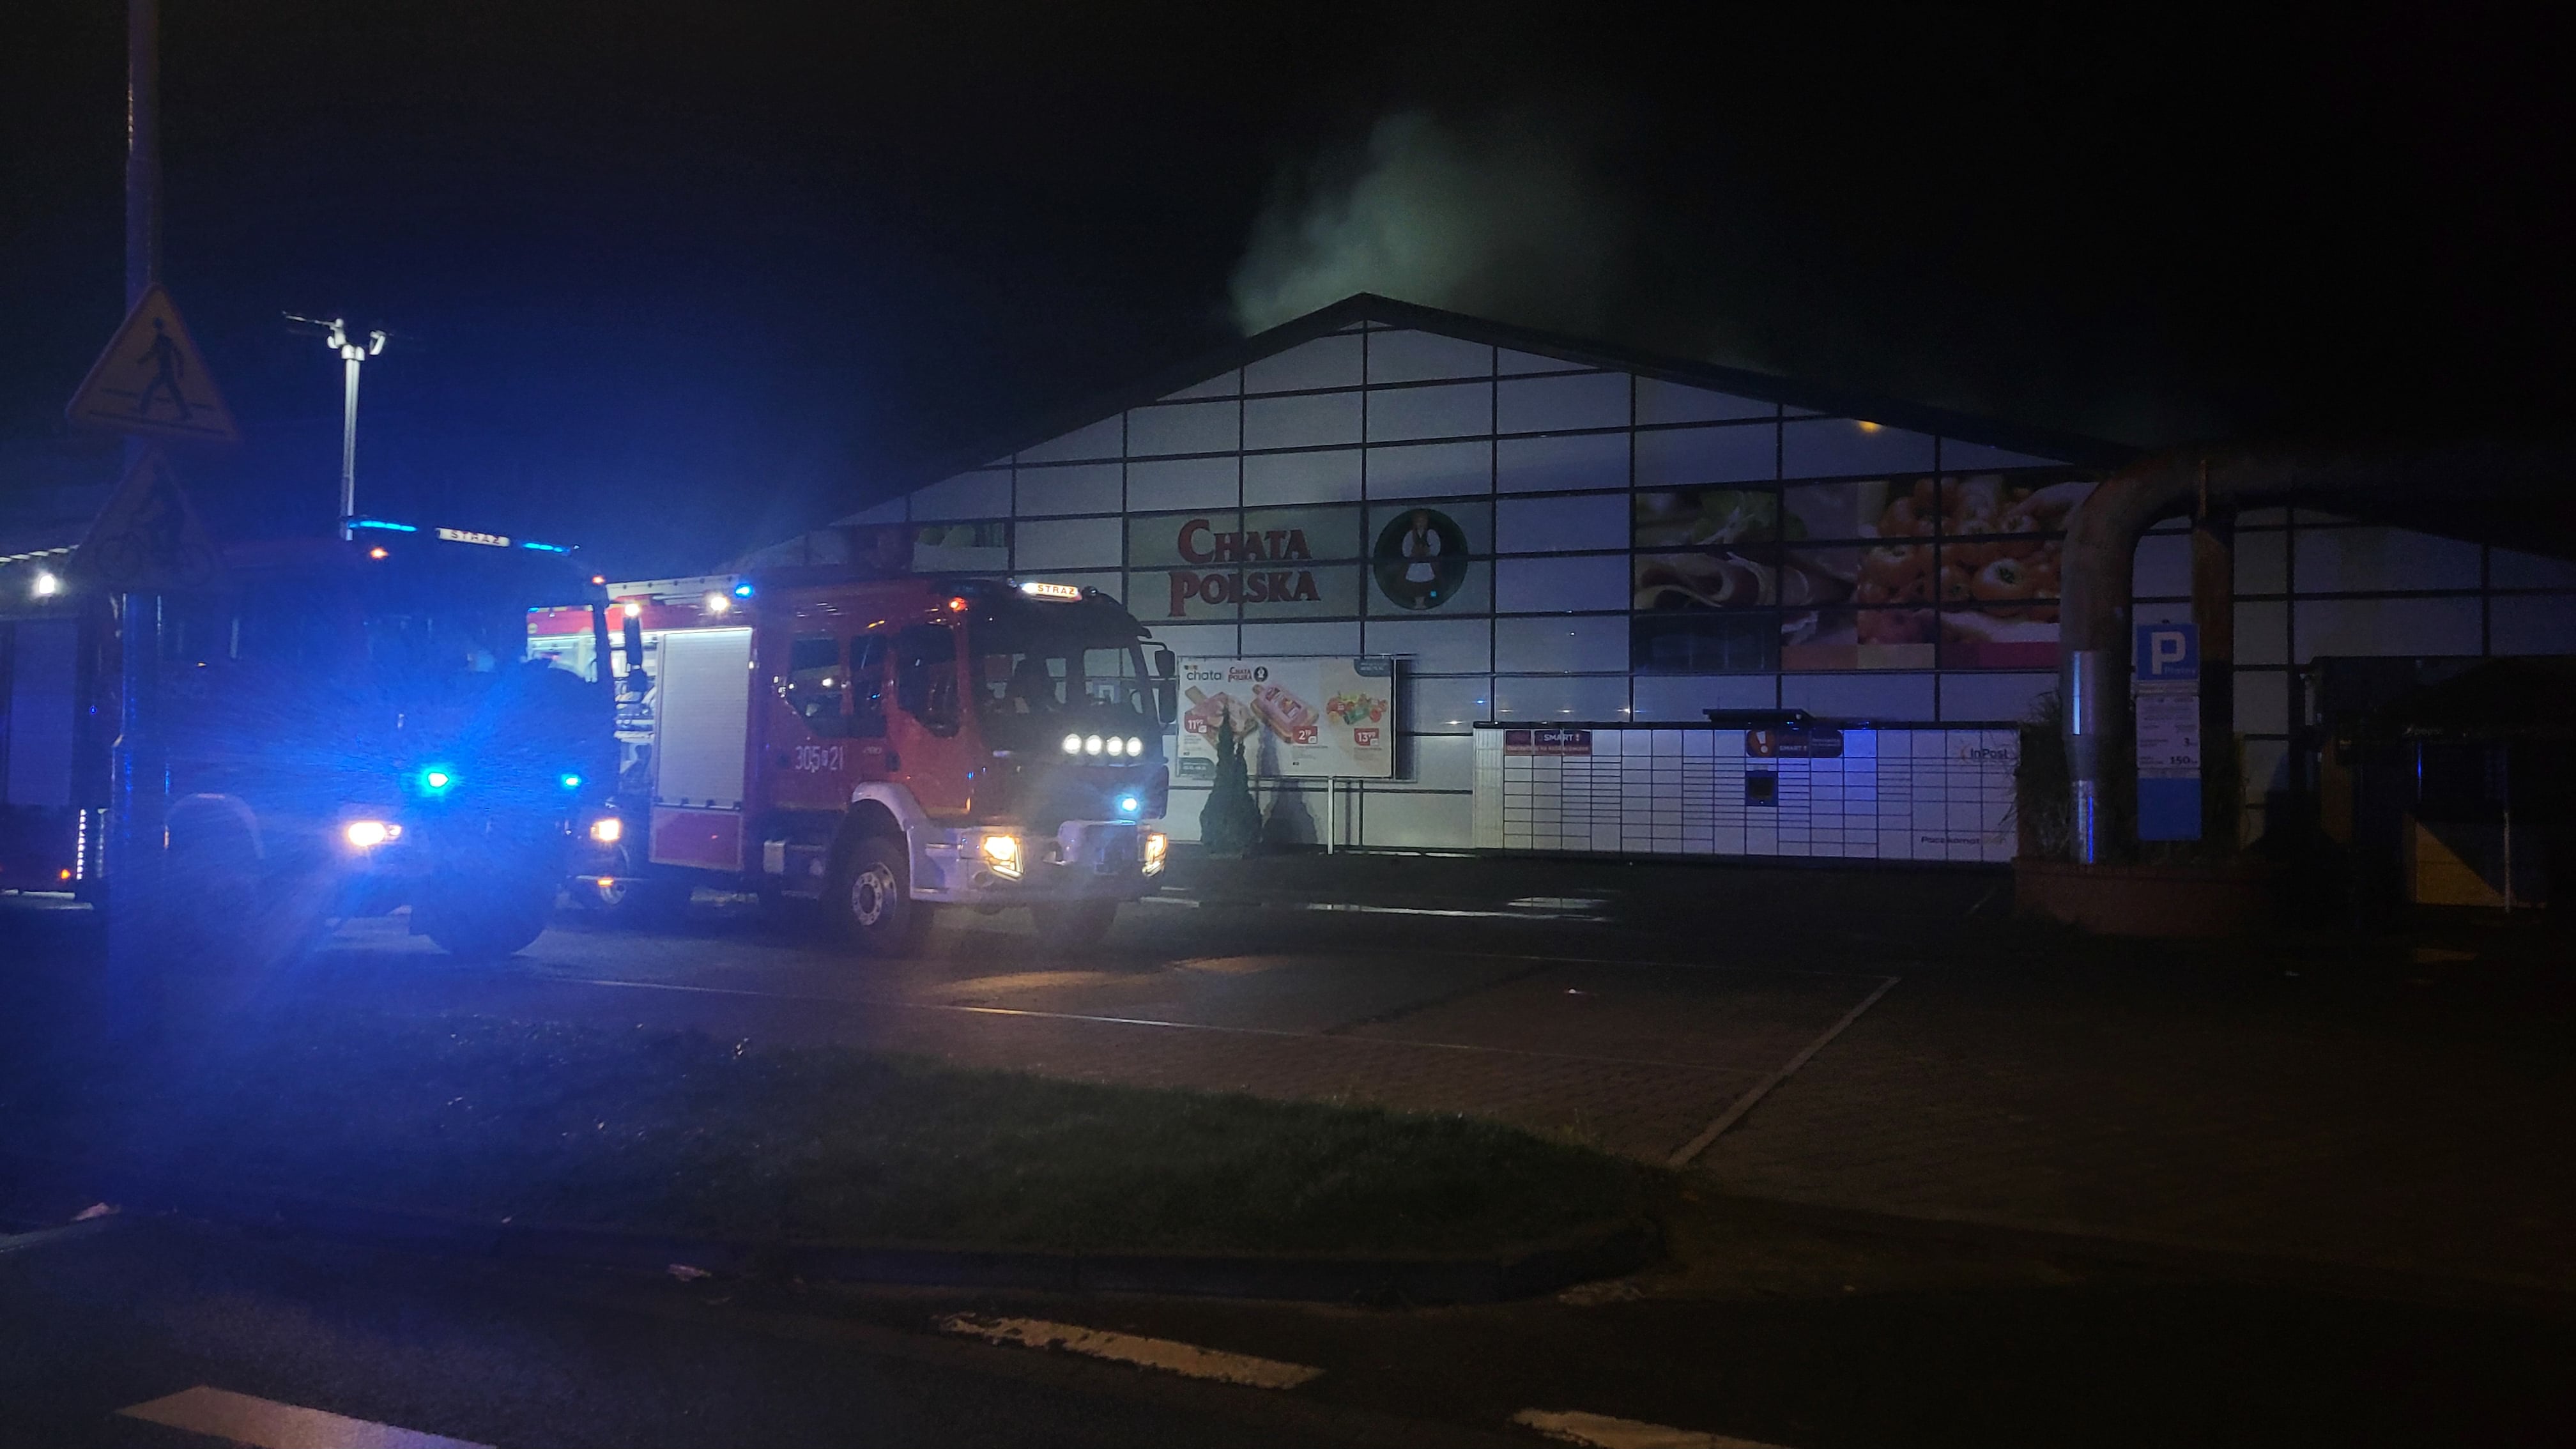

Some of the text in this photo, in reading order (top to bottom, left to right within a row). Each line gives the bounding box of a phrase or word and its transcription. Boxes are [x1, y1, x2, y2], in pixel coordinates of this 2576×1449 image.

[1178, 519, 1313, 564] CHATA
[1167, 571, 1321, 617] POLSKA
[1186, 670, 1222, 680] chata
[2151, 631, 2186, 675] P
[1970, 748, 2009, 758] InPost
